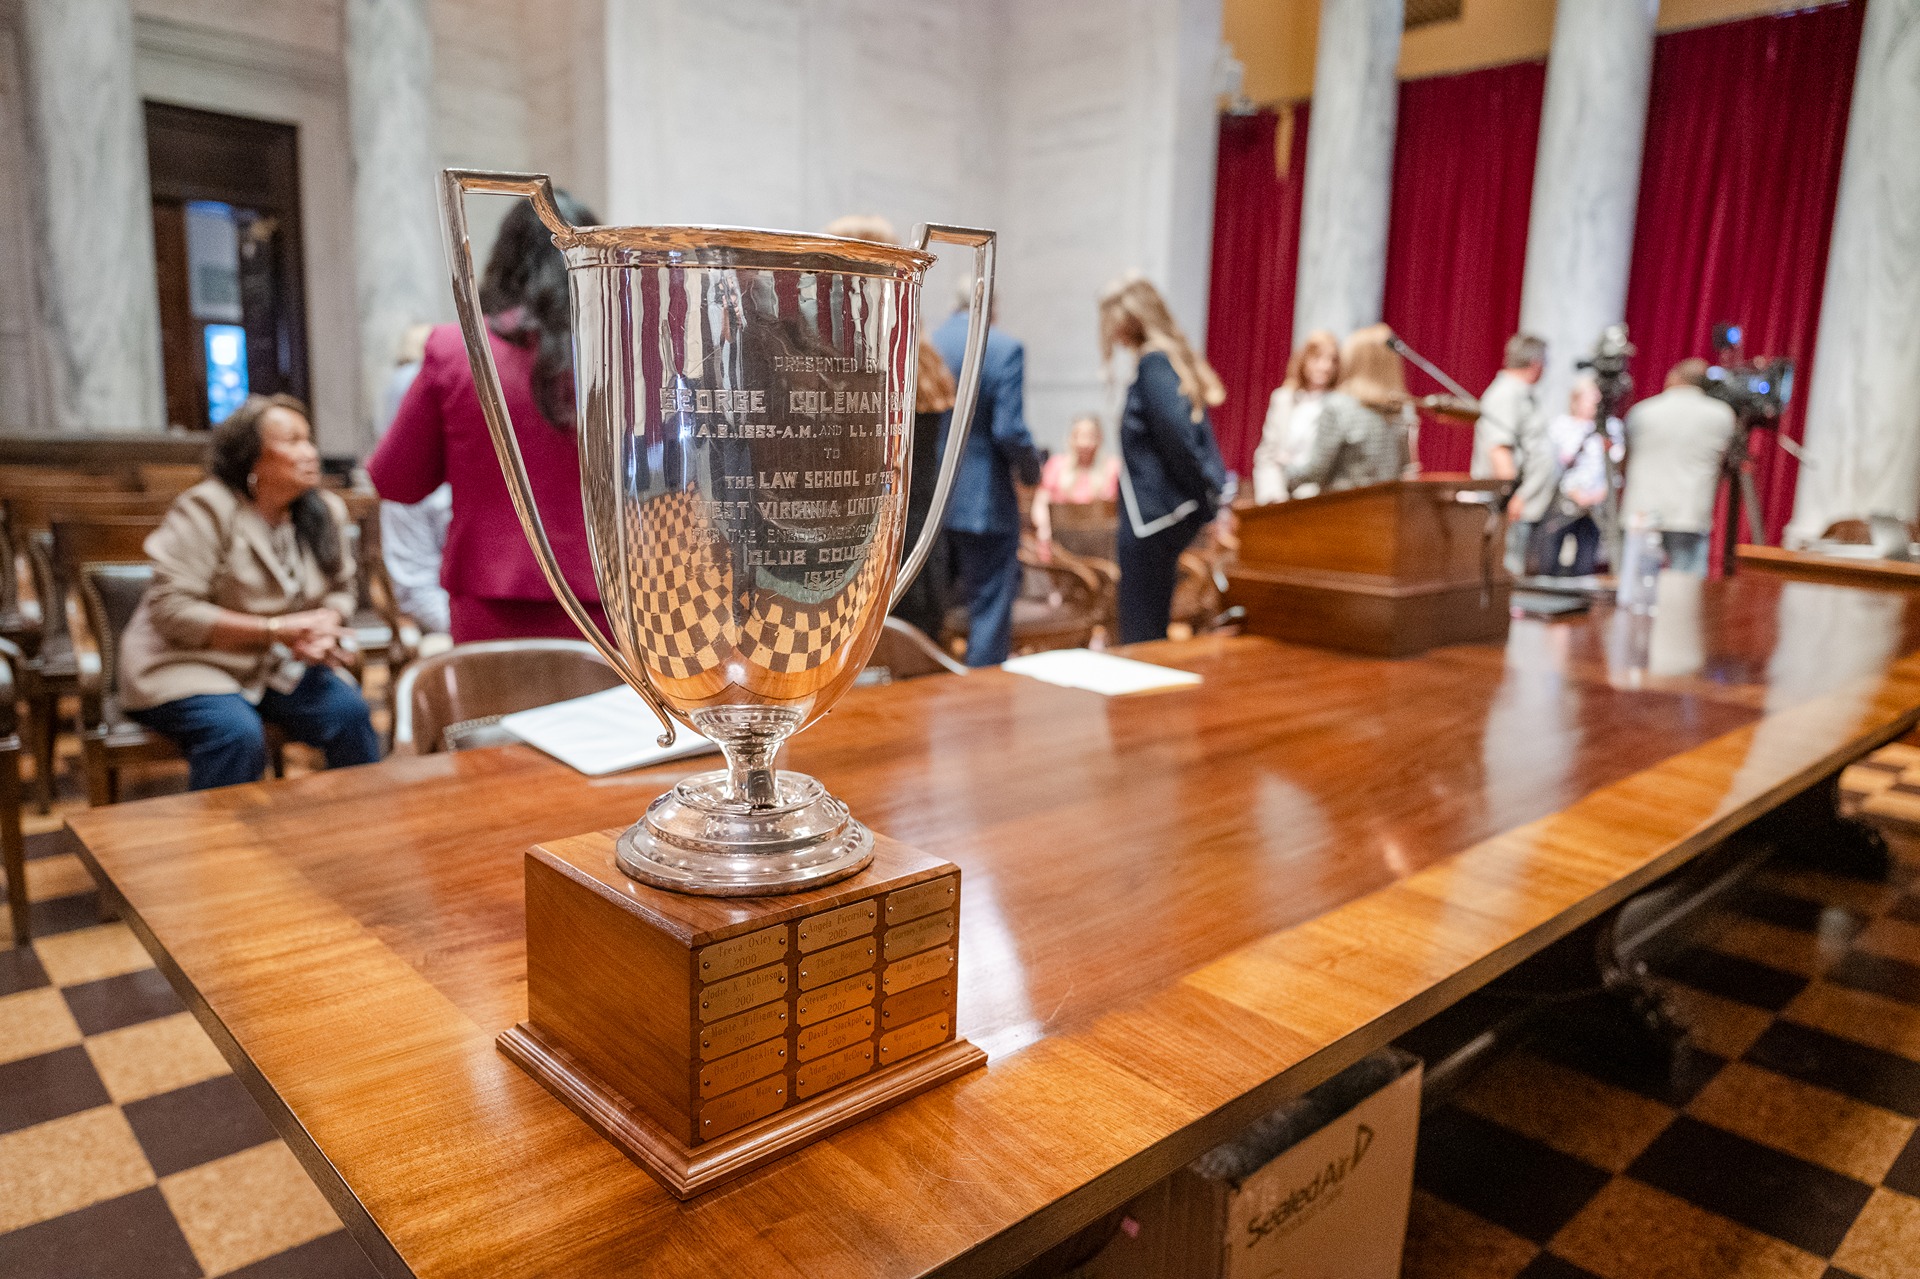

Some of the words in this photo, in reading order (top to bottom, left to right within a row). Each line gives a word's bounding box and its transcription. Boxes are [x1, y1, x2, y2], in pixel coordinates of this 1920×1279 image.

[774, 356, 858, 373] PRESENTED
[865, 357, 880, 374] BY
[659, 388, 767, 414] GEORGE
[789, 390, 882, 414] COLEMAN
[819, 425, 843, 436] AND
[823, 447, 841, 459] TO
[725, 475, 756, 489] THE
[759, 471, 799, 489] LAW
[804, 470, 860, 489] SCHOOL
[865, 472, 878, 486] OF
[690, 501, 750, 520] WEST
[757, 500, 841, 520] VIRGINIA
[728, 528, 757, 544] THE
[748, 549, 807, 566] CLUB
[808, 918, 832, 933] Angela
[828, 927, 848, 941] 2005
[718, 944, 743, 957] Treva
[748, 934, 771, 949] Oxley
[734, 954, 757, 969] 2000
[746, 970, 783, 988] Robinson
[828, 965, 848, 980] 2006
[735, 993, 755, 1008] 2001
[804, 993, 828, 1006] Steven
[828, 999, 847, 1014] 2007
[711, 1024, 737, 1038] Monte
[743, 1009, 778, 1028] Williams
[734, 1031, 756, 1047] 2002
[808, 1025, 828, 1042] David
[828, 1034, 847, 1049] 2008
[714, 1060, 739, 1076] David
[734, 1067, 756, 1084] 2003
[826, 1069, 846, 1085] 2009
